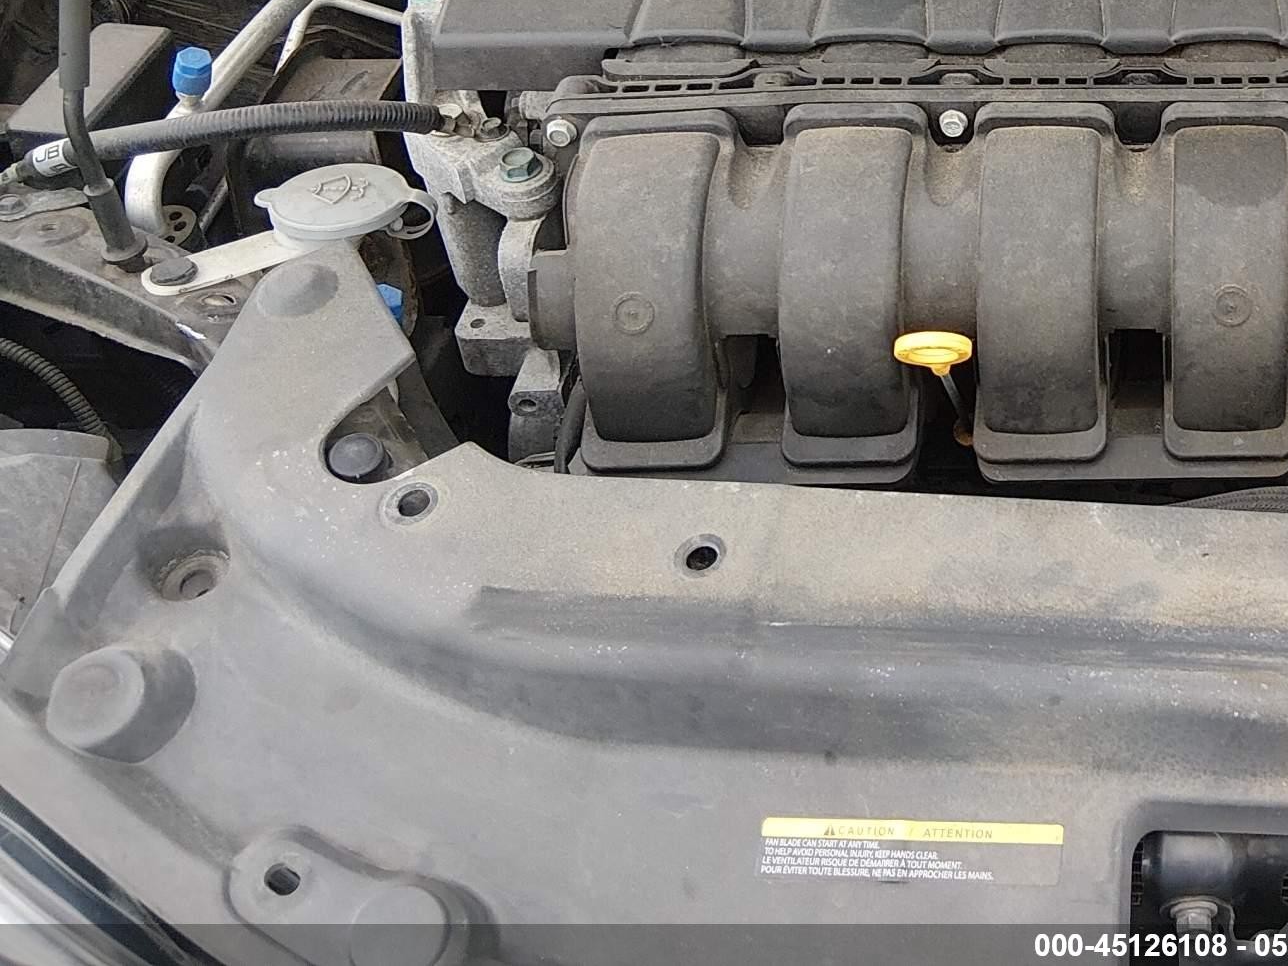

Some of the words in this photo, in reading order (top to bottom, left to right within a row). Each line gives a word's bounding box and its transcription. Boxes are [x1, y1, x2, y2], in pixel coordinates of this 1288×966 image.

[839, 825, 895, 836] CAUTION
[922, 828, 993, 839] ATTENTION
[765, 838, 778, 846] FAN
[780, 838, 801, 847] BLADE
[802, 839, 817, 847] CAN
[818, 839, 838, 848] START
[838, 840, 847, 848] AT
[848, 840, 862, 849] ANY
[765, 847, 774, 855] TO
[775, 847, 792, 855] HELP
[792, 848, 814, 856] AVOID
[815, 849, 848, 857] PERSONAL
[875, 850, 890, 858] KEEP
[891, 850, 915, 859] HANDS
[762, 856, 771, 864] LE
[772, 856, 819, 866] VENTILATEUR
[821, 858, 848, 867] RISQUE
[848, 859, 859, 867] DE
[907, 861, 927, 869] TOUT
[760, 865, 782, 874] POUR
[808, 866, 832, 875] TOUTE
[872, 869, 882, 877] NE
[883, 869, 896, 877] PAS
[897, 869, 907, 877] EN
[907, 870, 952, 879] APPROCHER
[953, 871, 967, 879] LES
